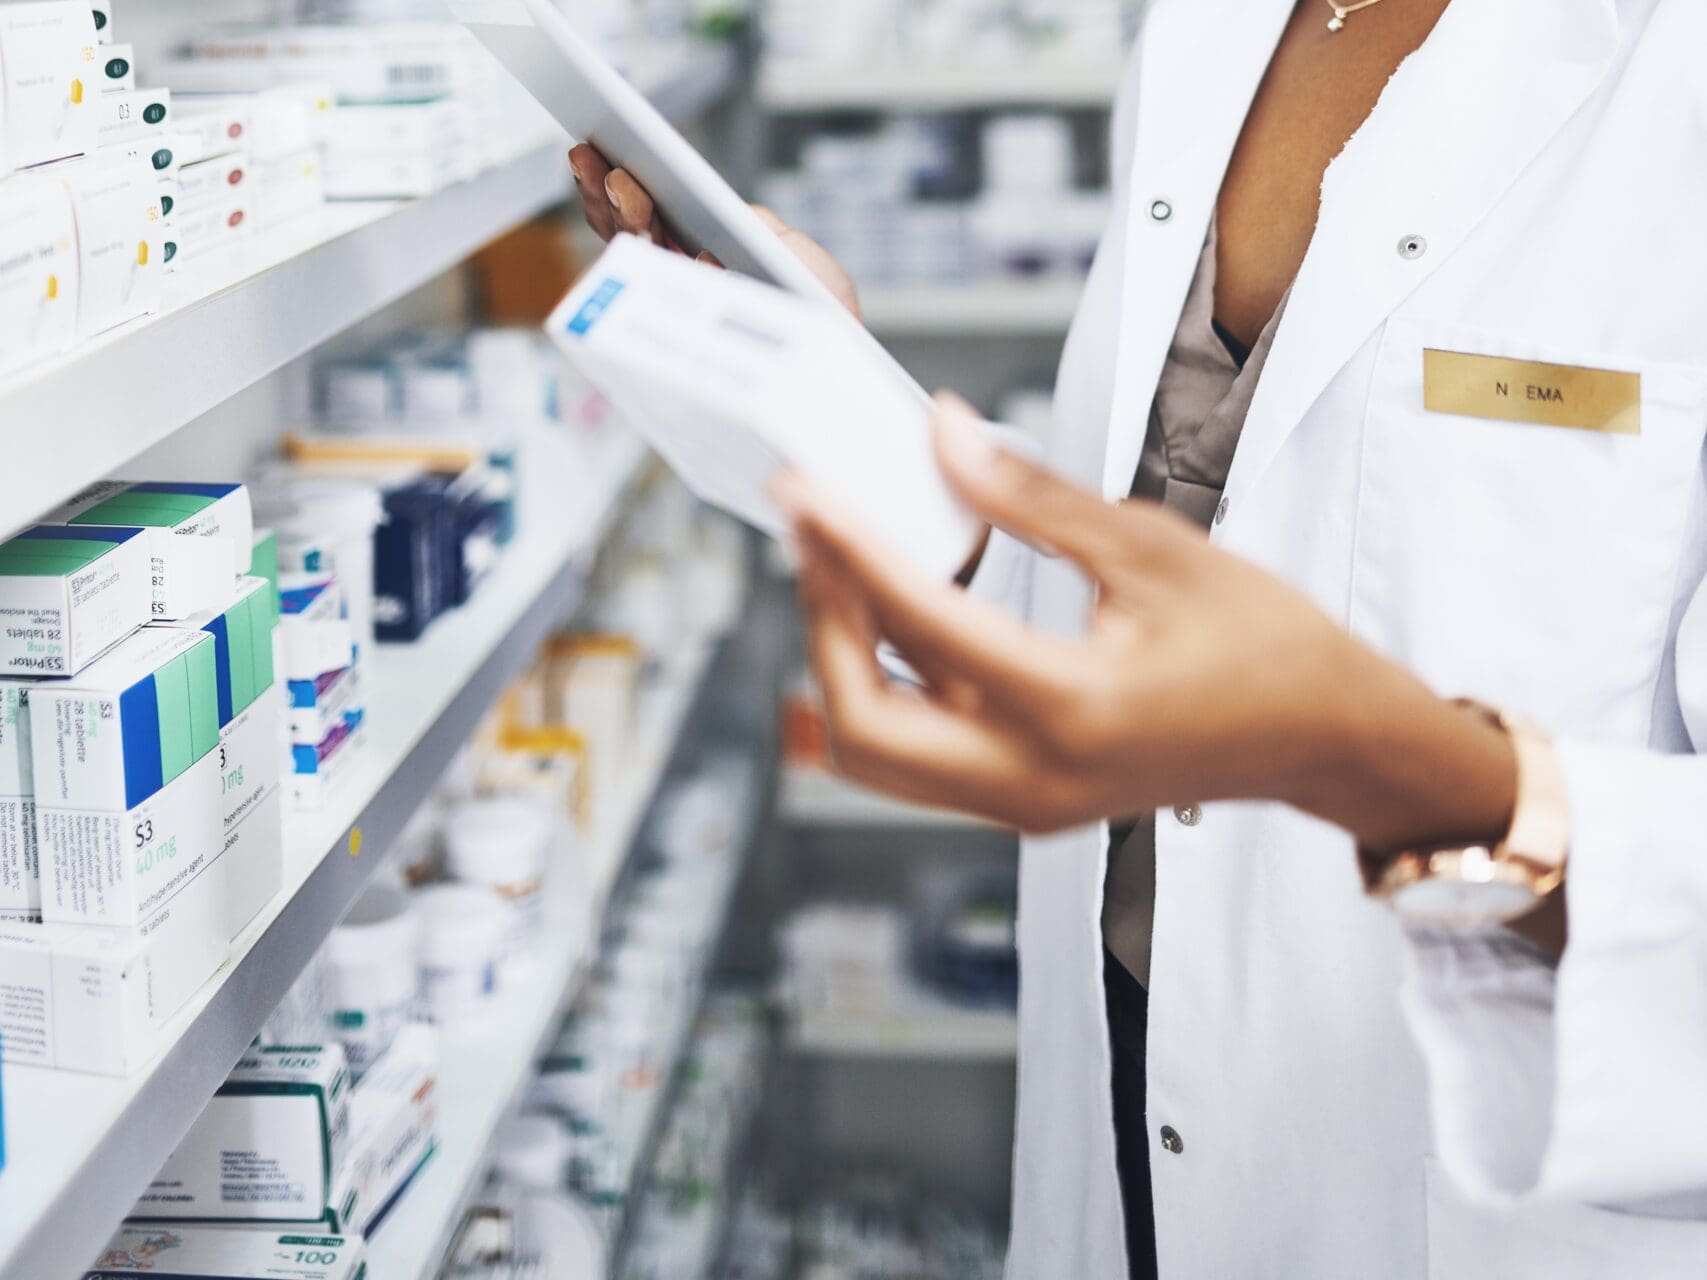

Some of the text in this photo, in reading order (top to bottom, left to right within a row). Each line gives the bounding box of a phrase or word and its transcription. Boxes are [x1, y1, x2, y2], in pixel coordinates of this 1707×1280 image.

[1526, 385, 1564, 403] EMA
[6, 629, 61, 640] 28 tablets
[136, 820, 153, 848] S3
